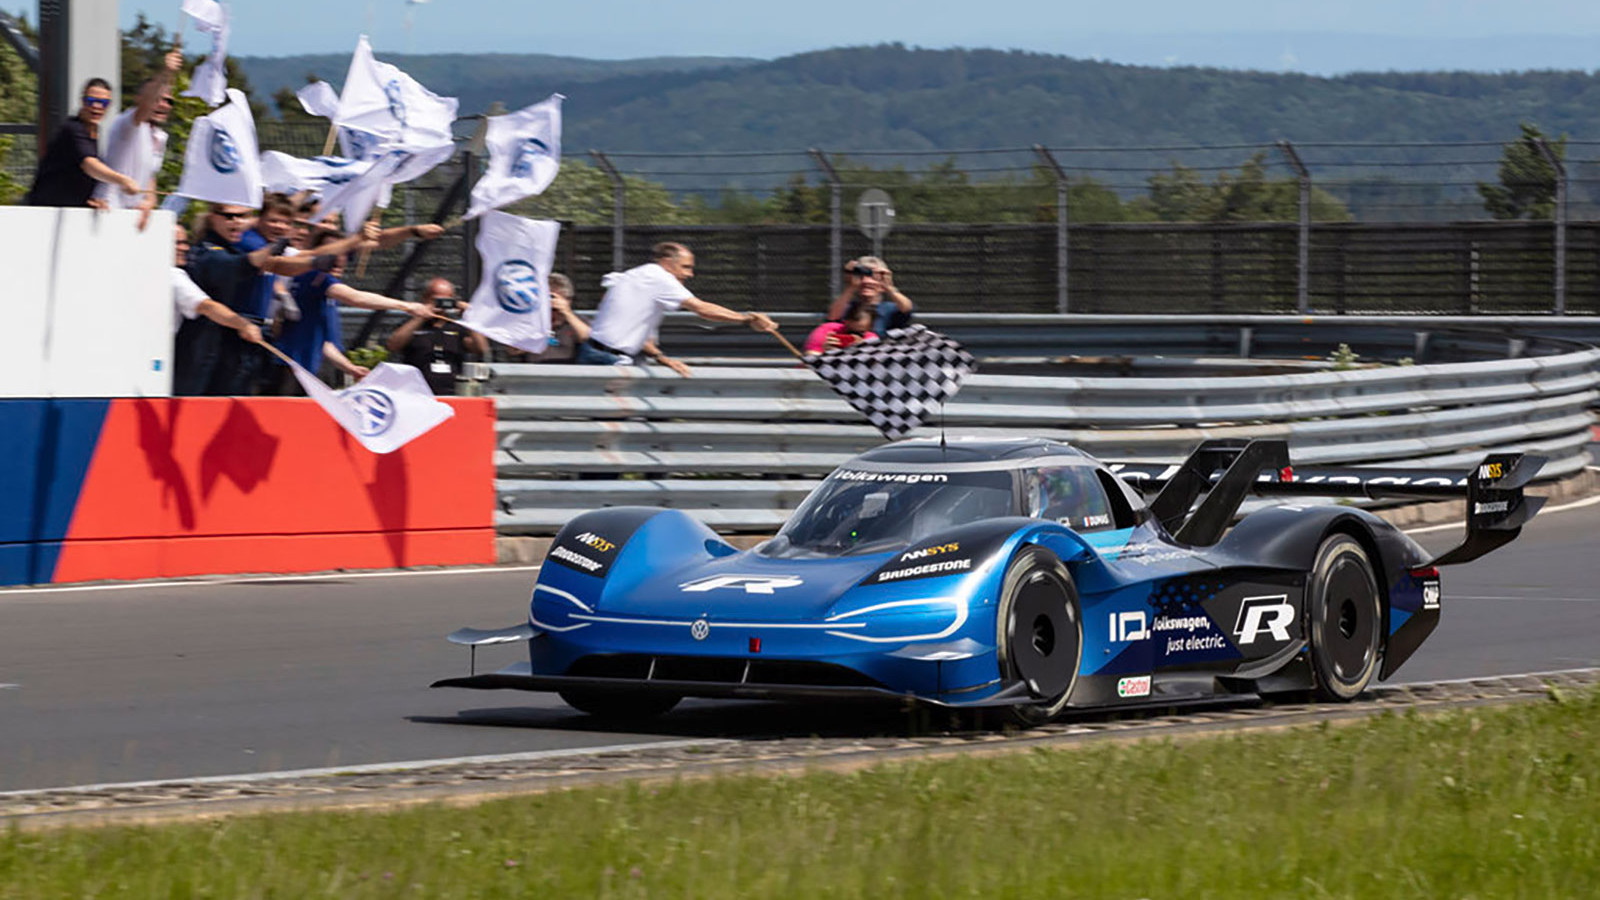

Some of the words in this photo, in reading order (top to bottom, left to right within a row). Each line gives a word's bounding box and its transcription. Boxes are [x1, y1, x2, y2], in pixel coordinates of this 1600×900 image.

[575, 532, 615, 552] ANSYS
[901, 542, 960, 561] ANSYS
[878, 559, 971, 581] BRIDGESTONE
[1233, 595, 1295, 645] R
[1165, 636, 1185, 656] just
[1186, 633, 1226, 650] electric.
